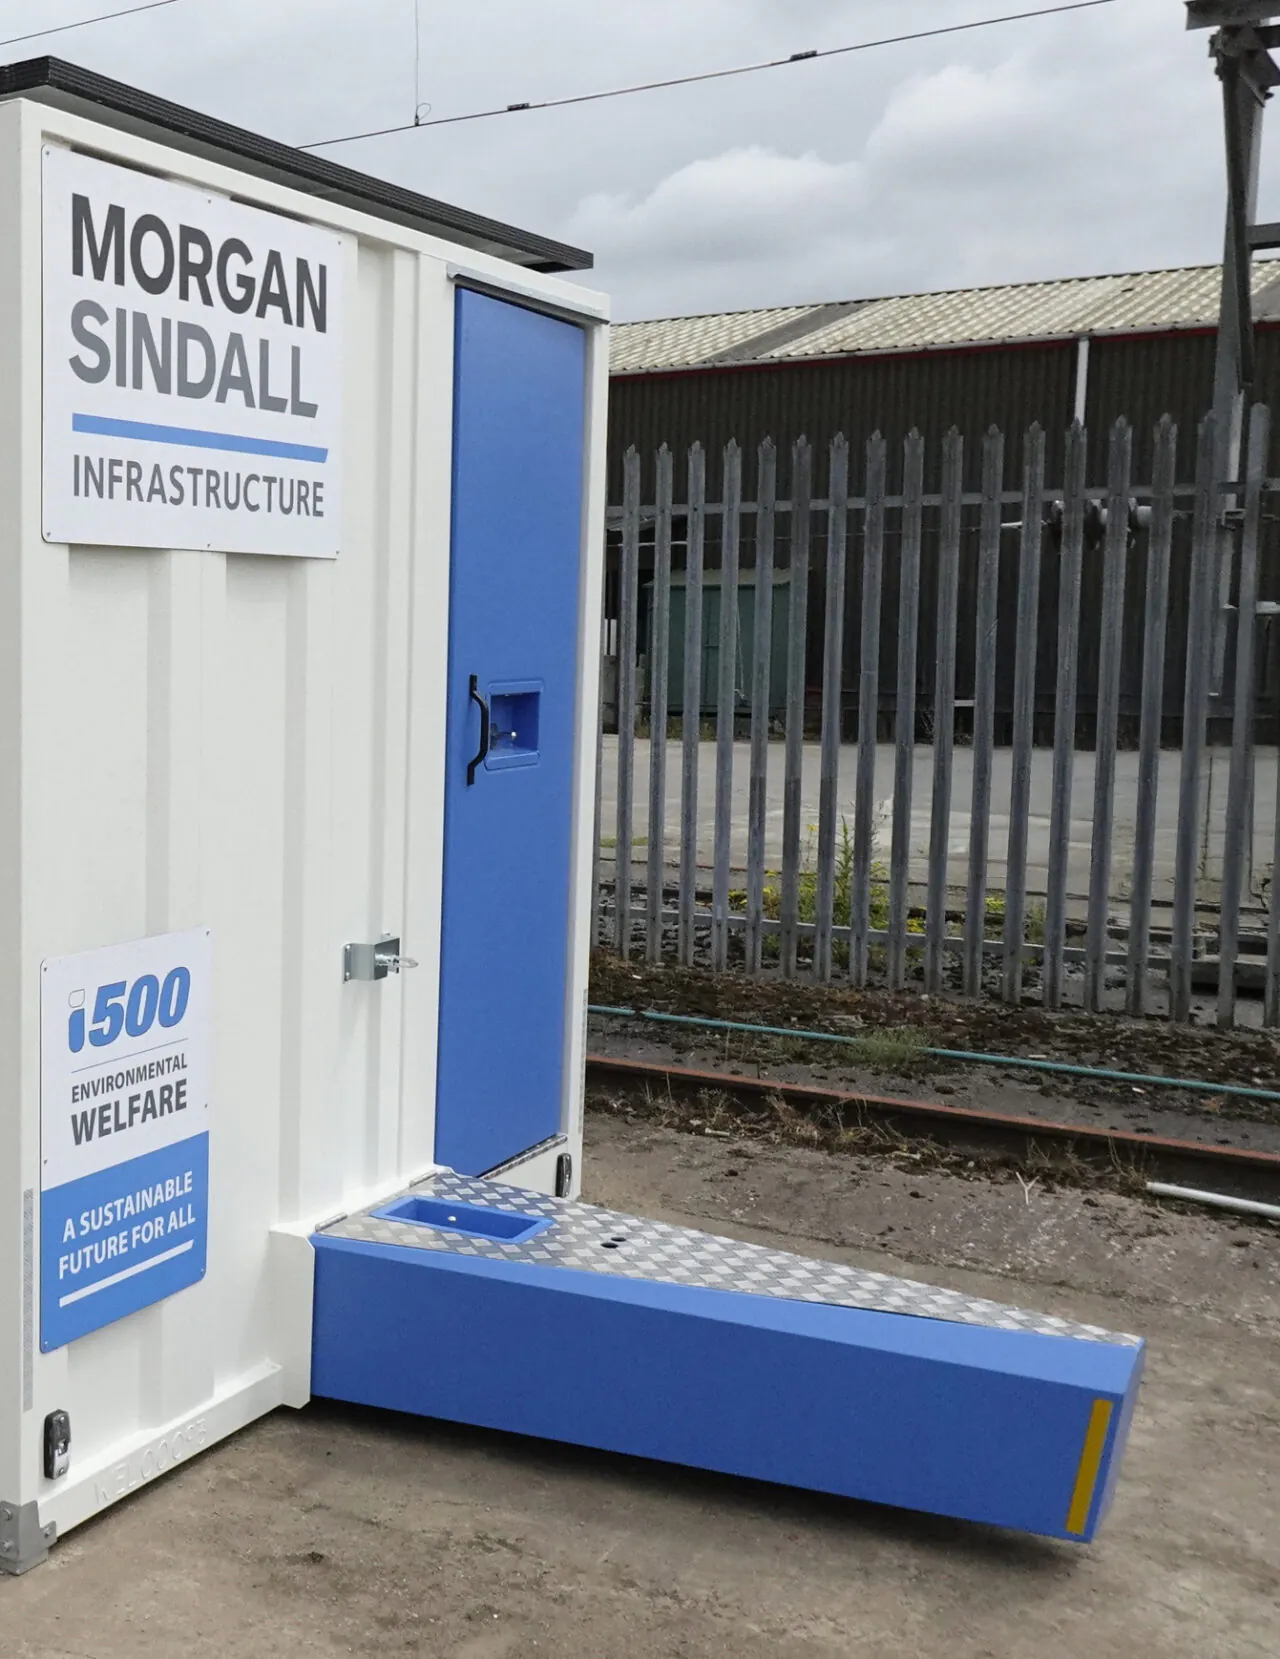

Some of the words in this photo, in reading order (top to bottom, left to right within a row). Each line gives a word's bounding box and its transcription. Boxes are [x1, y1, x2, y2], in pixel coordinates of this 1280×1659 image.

[72, 192, 328, 334] MORGAN
[68, 299, 319, 419] SINDALL
[73, 453, 325, 518] INFRASTRUCTURE
[68, 965, 191, 1054] i500
[71, 1052, 188, 1104] ENVIRONMENTAL
[71, 1078, 188, 1146] WELFARE
[59, 1230, 129, 1280] FUTURE
[131, 1216, 165, 1249] FOR
[167, 1203, 196, 1235] ALL
[62, 1218, 76, 1243] A
[79, 1170, 193, 1237] SUSTAINABLE
